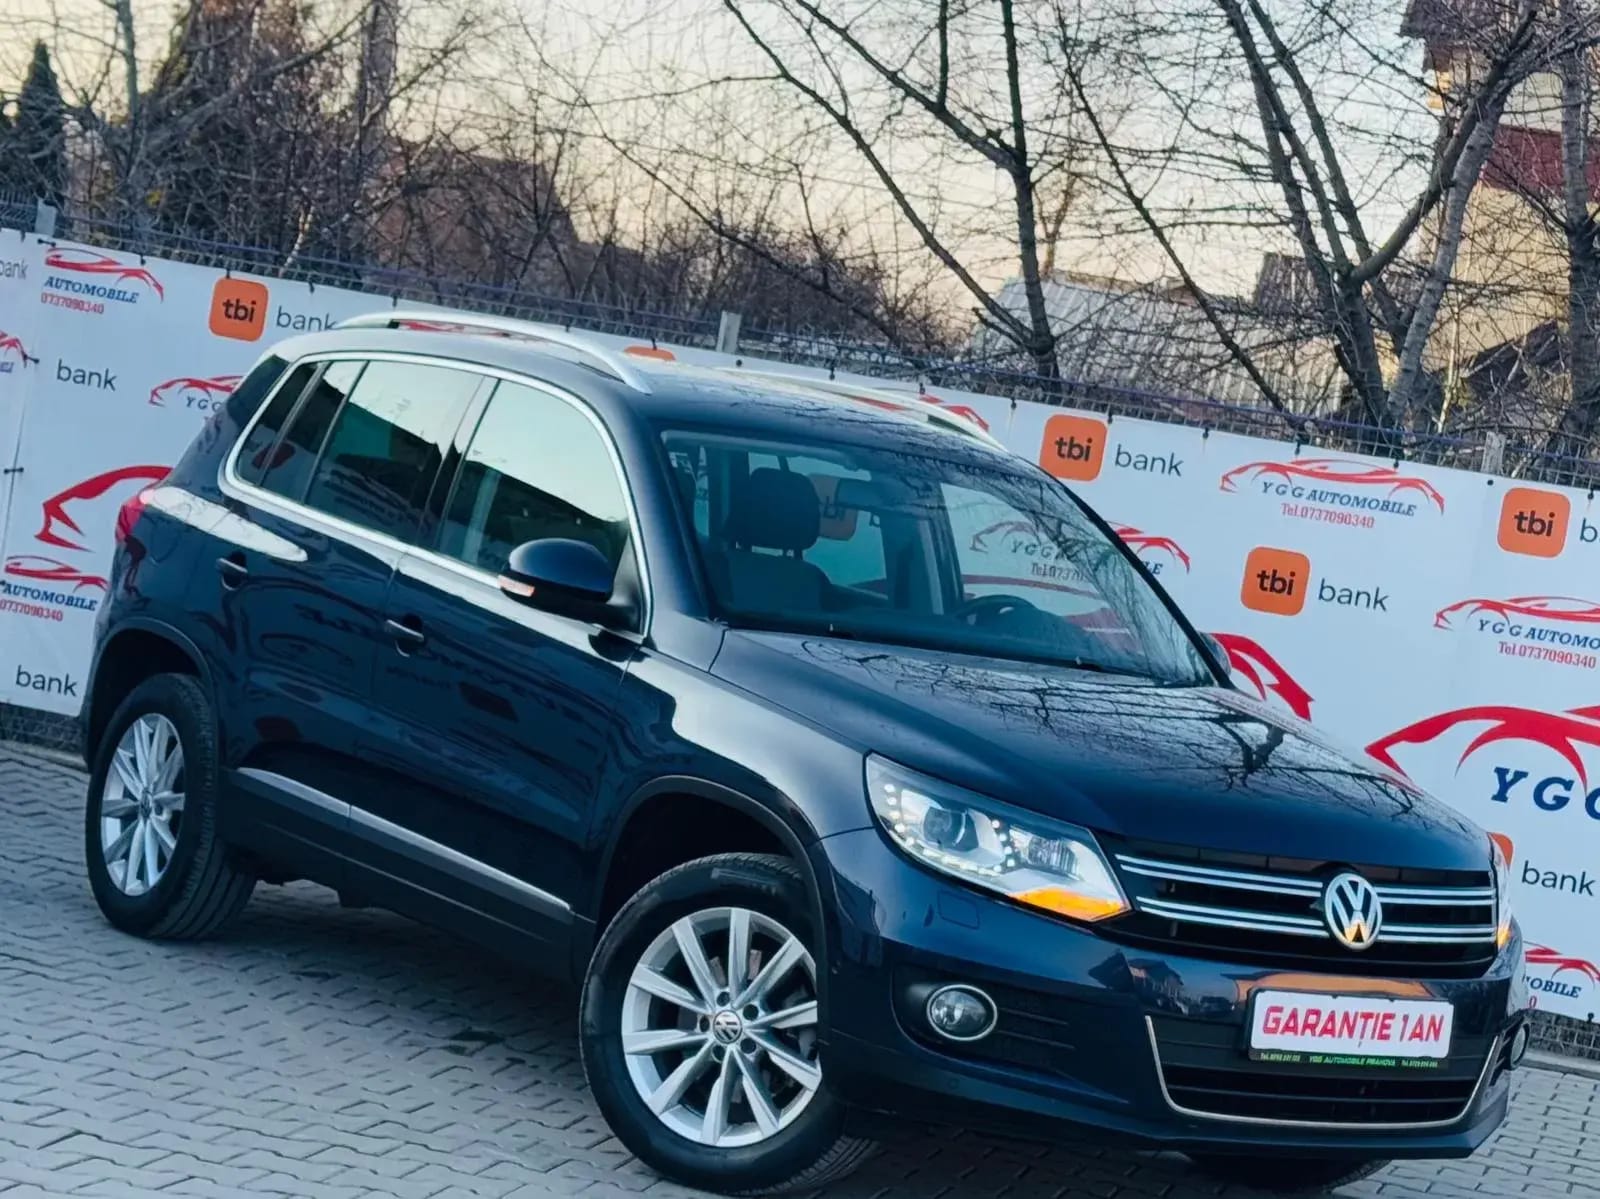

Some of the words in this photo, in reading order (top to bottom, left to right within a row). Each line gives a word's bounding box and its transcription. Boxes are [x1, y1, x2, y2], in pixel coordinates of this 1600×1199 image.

[44, 275, 139, 304] AUTOMOBILE
[222, 298, 257, 323] tbi
[276, 305, 338, 332] bank
[56, 359, 117, 392] bank
[1054, 435, 1093, 463] tbi
[1114, 443, 1183, 478] bank
[1305, 489, 1417, 518] AUTOMOBILE
[1513, 510, 1556, 537] tbi
[1256, 566, 1296, 597] tbi
[1318, 577, 1389, 613] bank
[3, 583, 98, 612] AUTOMOBILE
[15, 664, 77, 697] bank
[1521, 859, 1596, 897] bank
[1408, 1013, 1445, 1043] AN
